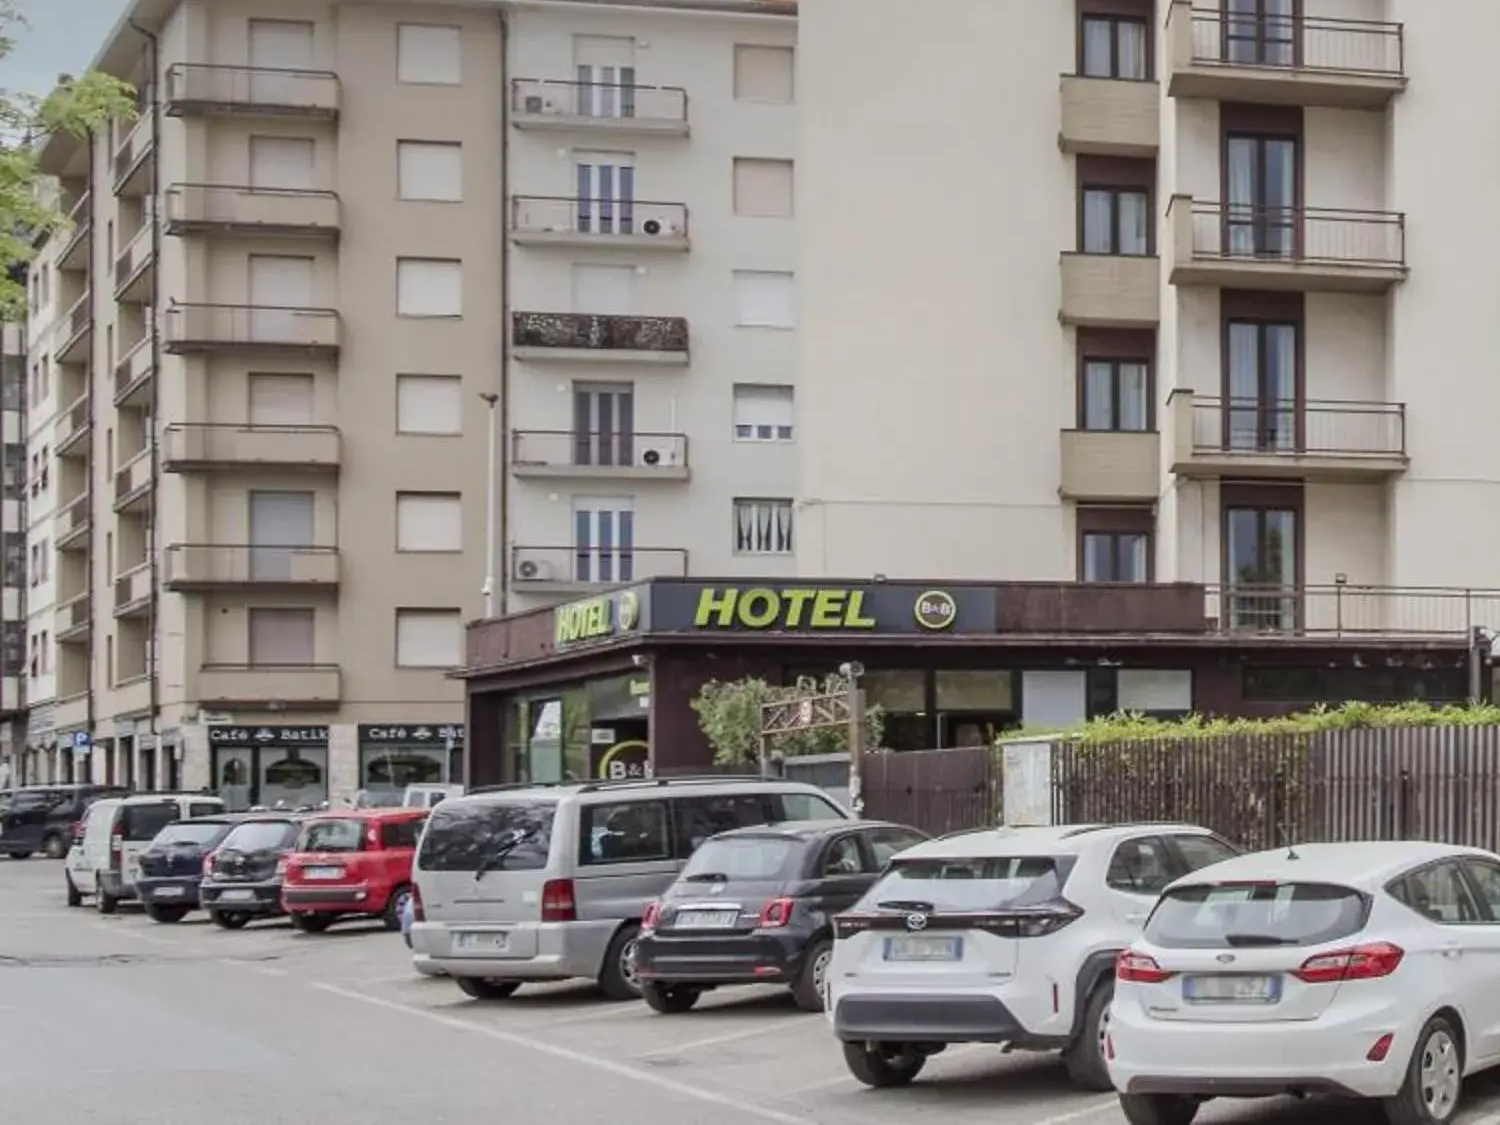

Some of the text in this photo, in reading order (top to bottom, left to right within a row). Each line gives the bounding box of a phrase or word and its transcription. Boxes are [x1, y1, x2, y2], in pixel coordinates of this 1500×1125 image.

[556, 596, 612, 642] HOTEL
[694, 588, 875, 627] HOTEL
[922, 602, 951, 615] B&B
